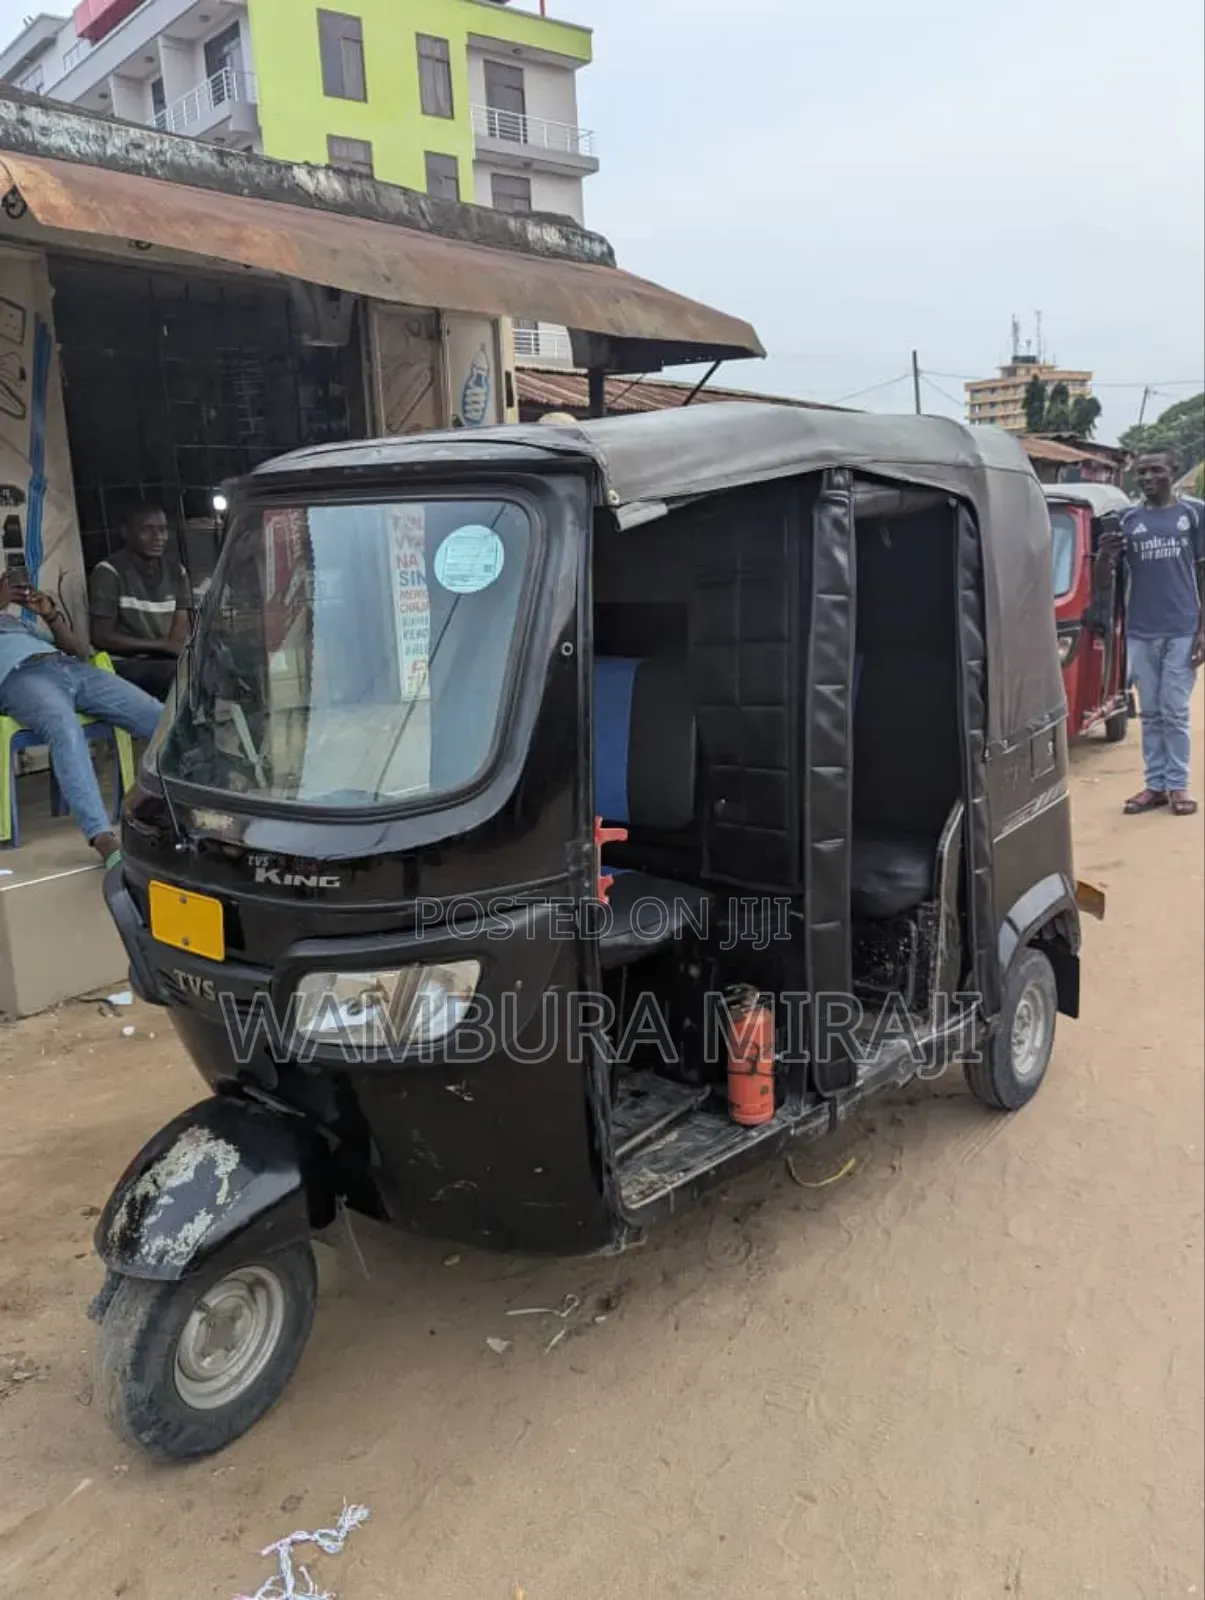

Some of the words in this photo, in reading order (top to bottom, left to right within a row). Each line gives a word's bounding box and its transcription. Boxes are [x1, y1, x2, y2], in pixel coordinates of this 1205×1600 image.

[248, 855, 270, 867] TVS
[255, 867, 341, 888] KING
[173, 967, 217, 1001] TVS
